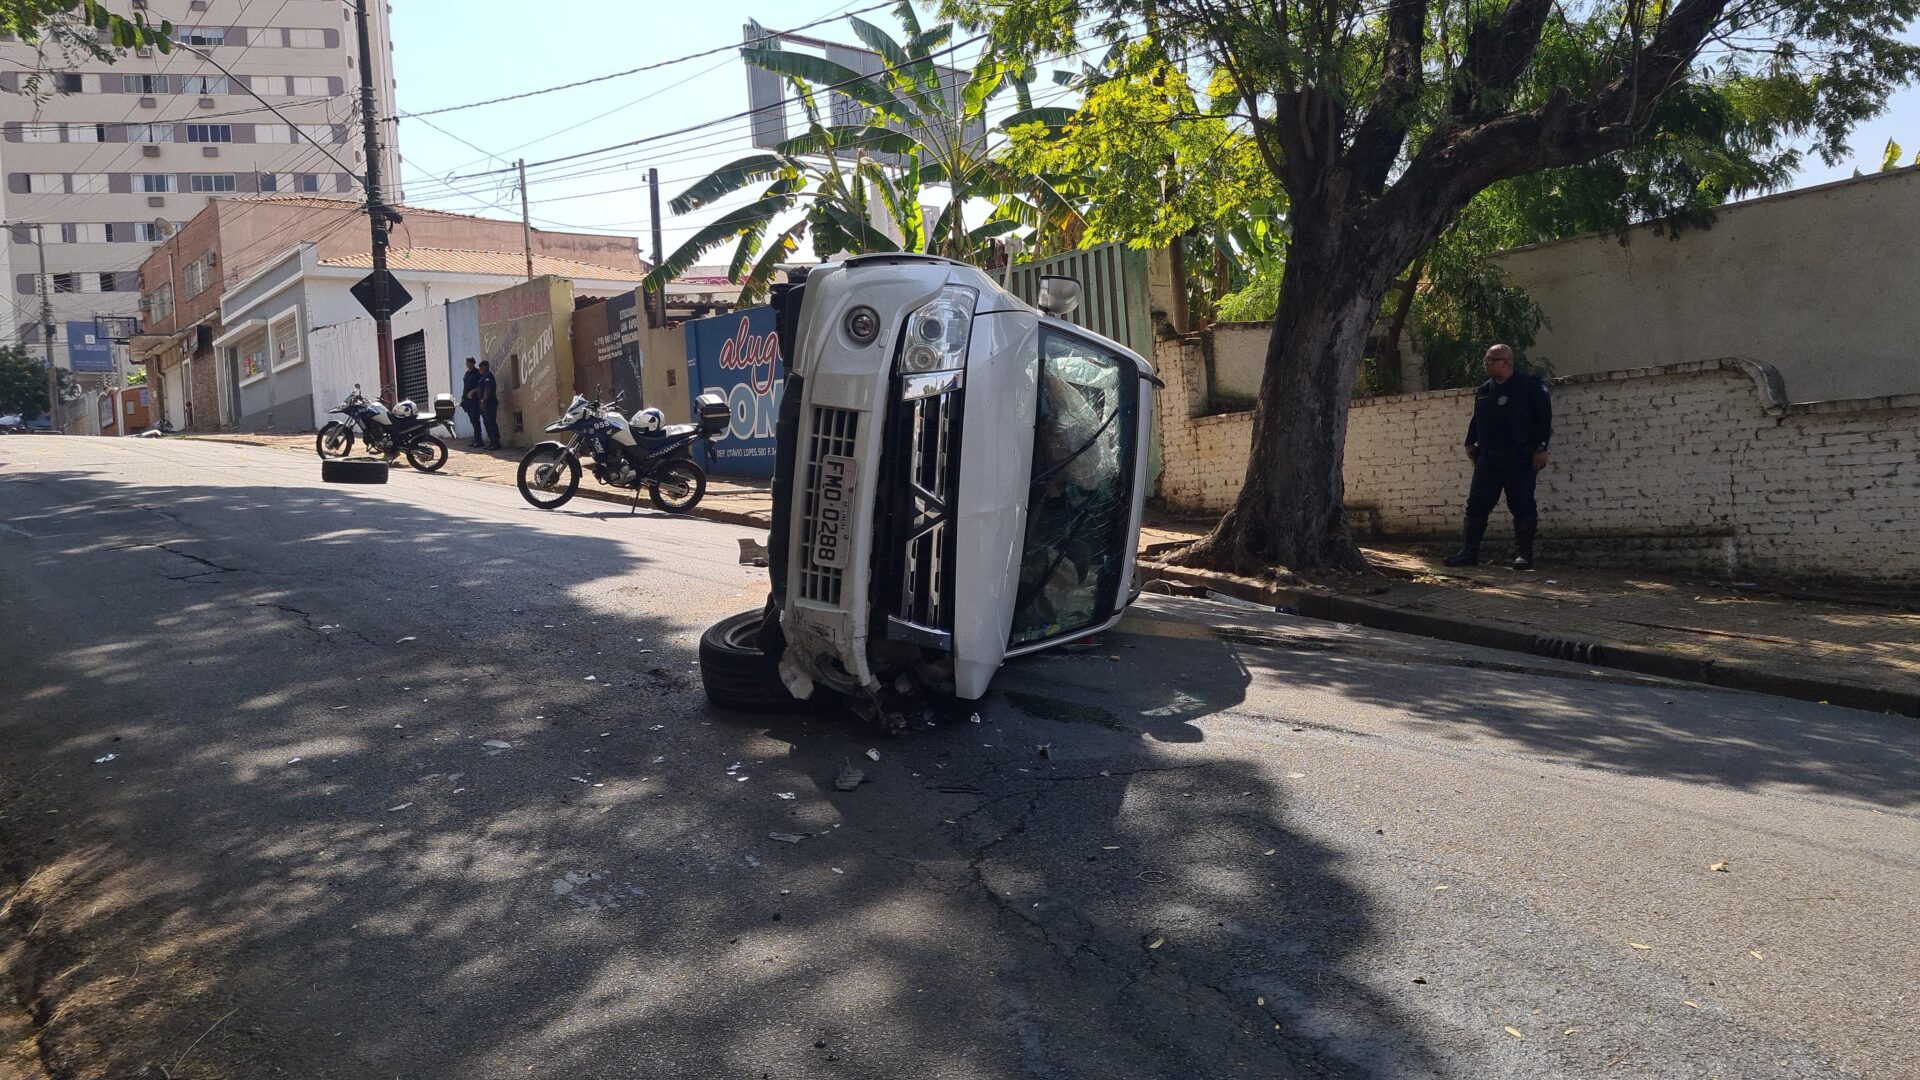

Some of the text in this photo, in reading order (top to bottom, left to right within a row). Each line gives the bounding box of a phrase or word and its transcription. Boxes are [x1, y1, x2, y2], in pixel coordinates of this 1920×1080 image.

[521, 323, 553, 385] CENTRO
[719, 316, 783, 396] alug
[594, 421, 610, 430] 955
